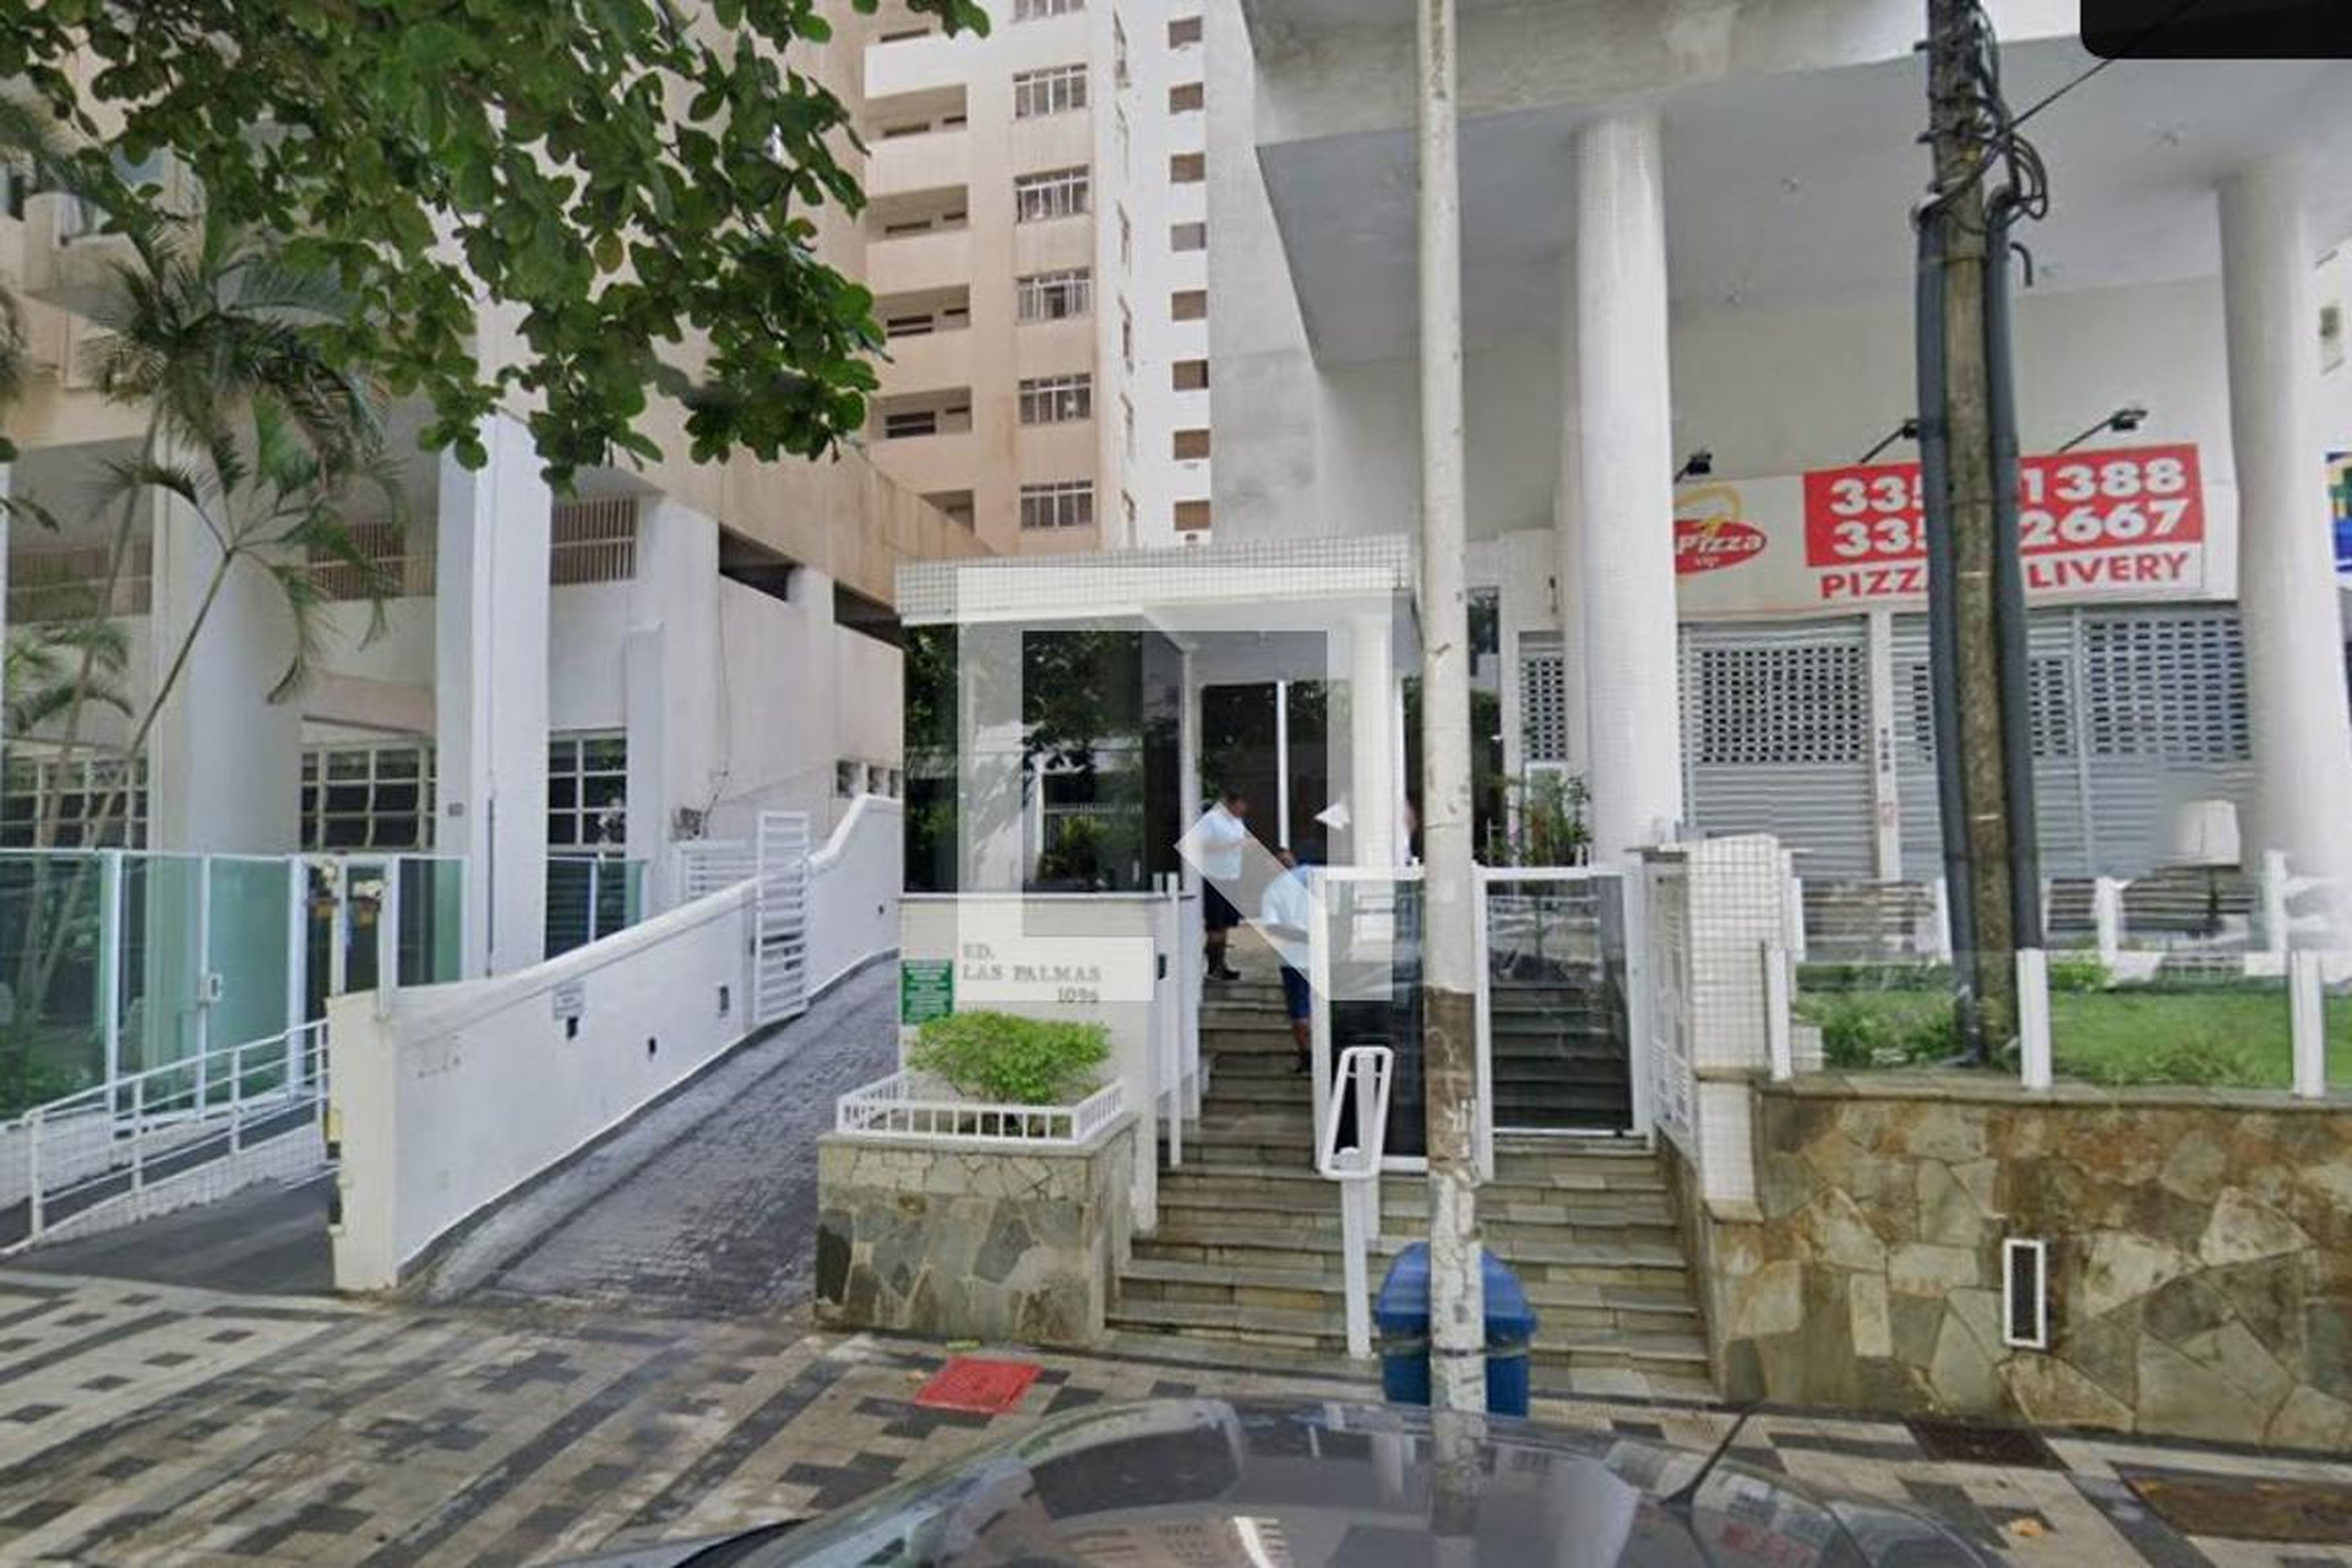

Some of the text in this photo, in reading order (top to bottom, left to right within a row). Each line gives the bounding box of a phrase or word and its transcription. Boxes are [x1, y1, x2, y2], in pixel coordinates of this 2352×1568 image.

[1830, 458, 2187, 516] 33 1388
[2019, 499, 2189, 546] 2667
[1821, 552, 2188, 599] PIZZ LIVERY
[963, 963, 1101, 982] LAS PALMAS
